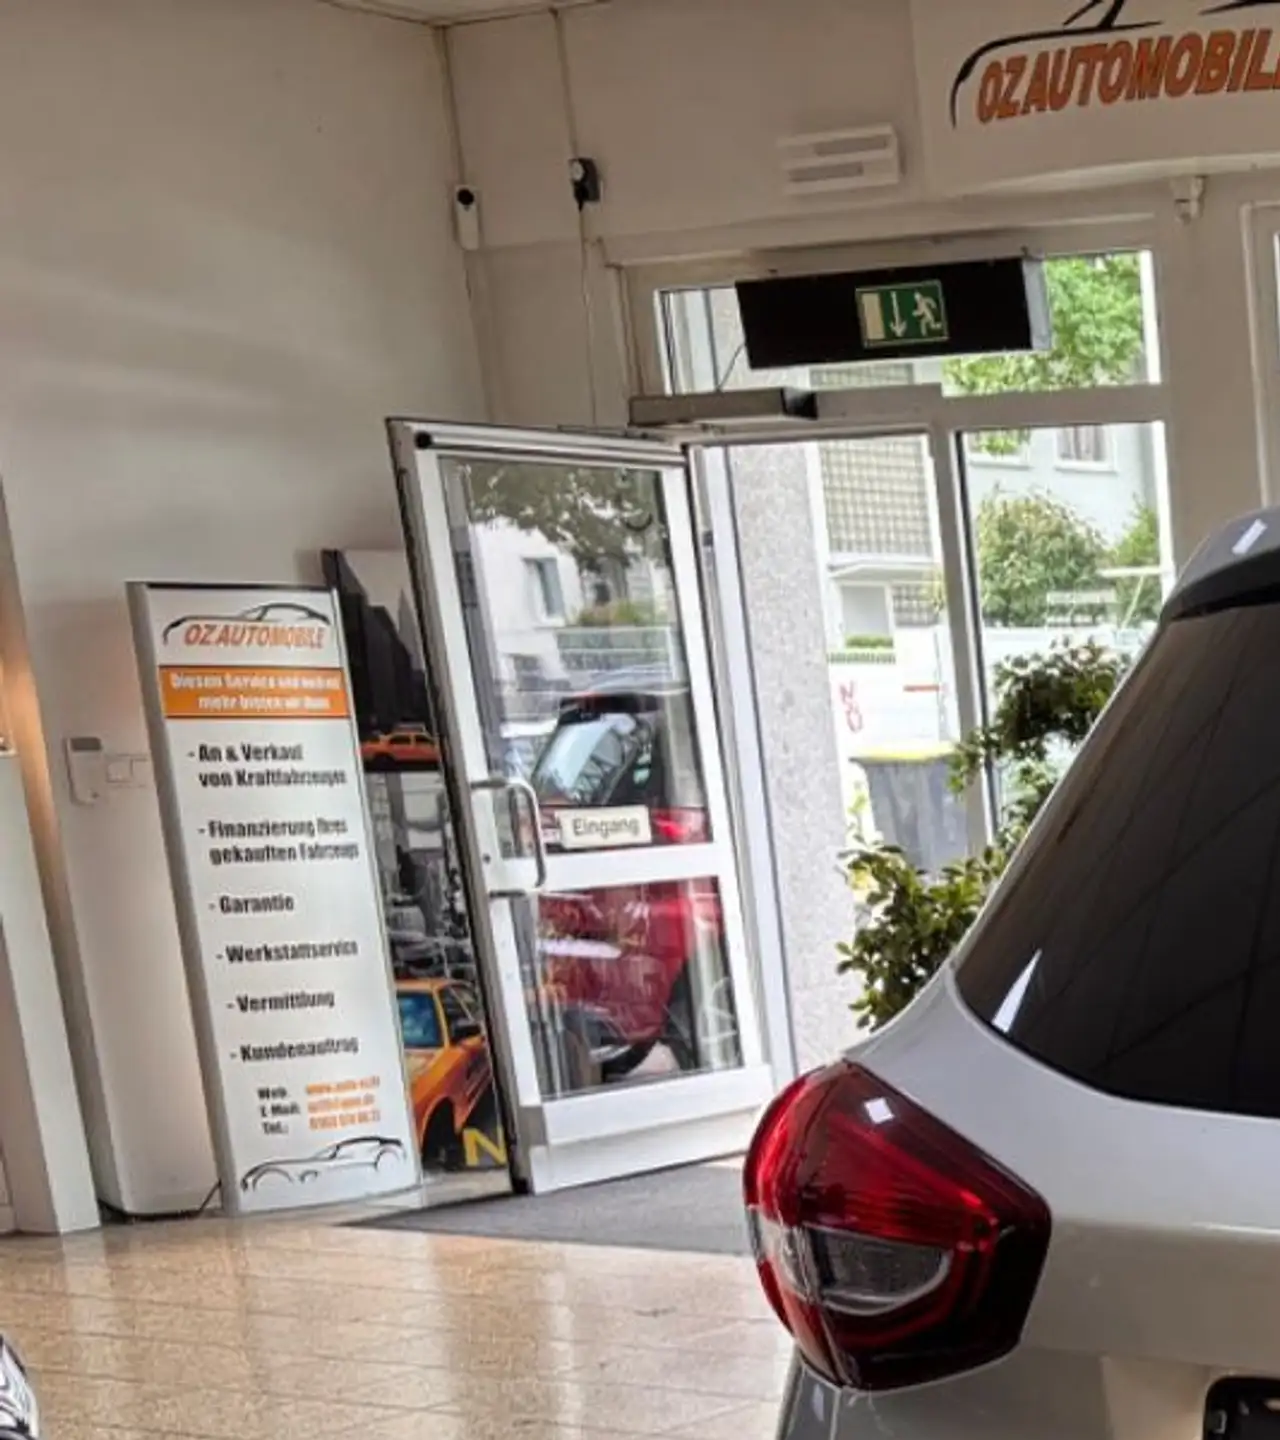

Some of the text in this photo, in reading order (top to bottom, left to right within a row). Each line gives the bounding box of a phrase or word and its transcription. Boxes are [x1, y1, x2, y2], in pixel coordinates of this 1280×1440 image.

[199, 743, 222, 762] An
[241, 742, 304, 761] Verkauf
[199, 770, 233, 788] von
[208, 818, 315, 839] Finanzierung
[572, 818, 640, 840] Eingang
[209, 845, 297, 866] gekauften
[220, 893, 295, 914] Garantie
[226, 941, 359, 963] Werkstattservice
[236, 991, 336, 1013] Vermittlung
[240, 1037, 360, 1063] Kundenauftrag
